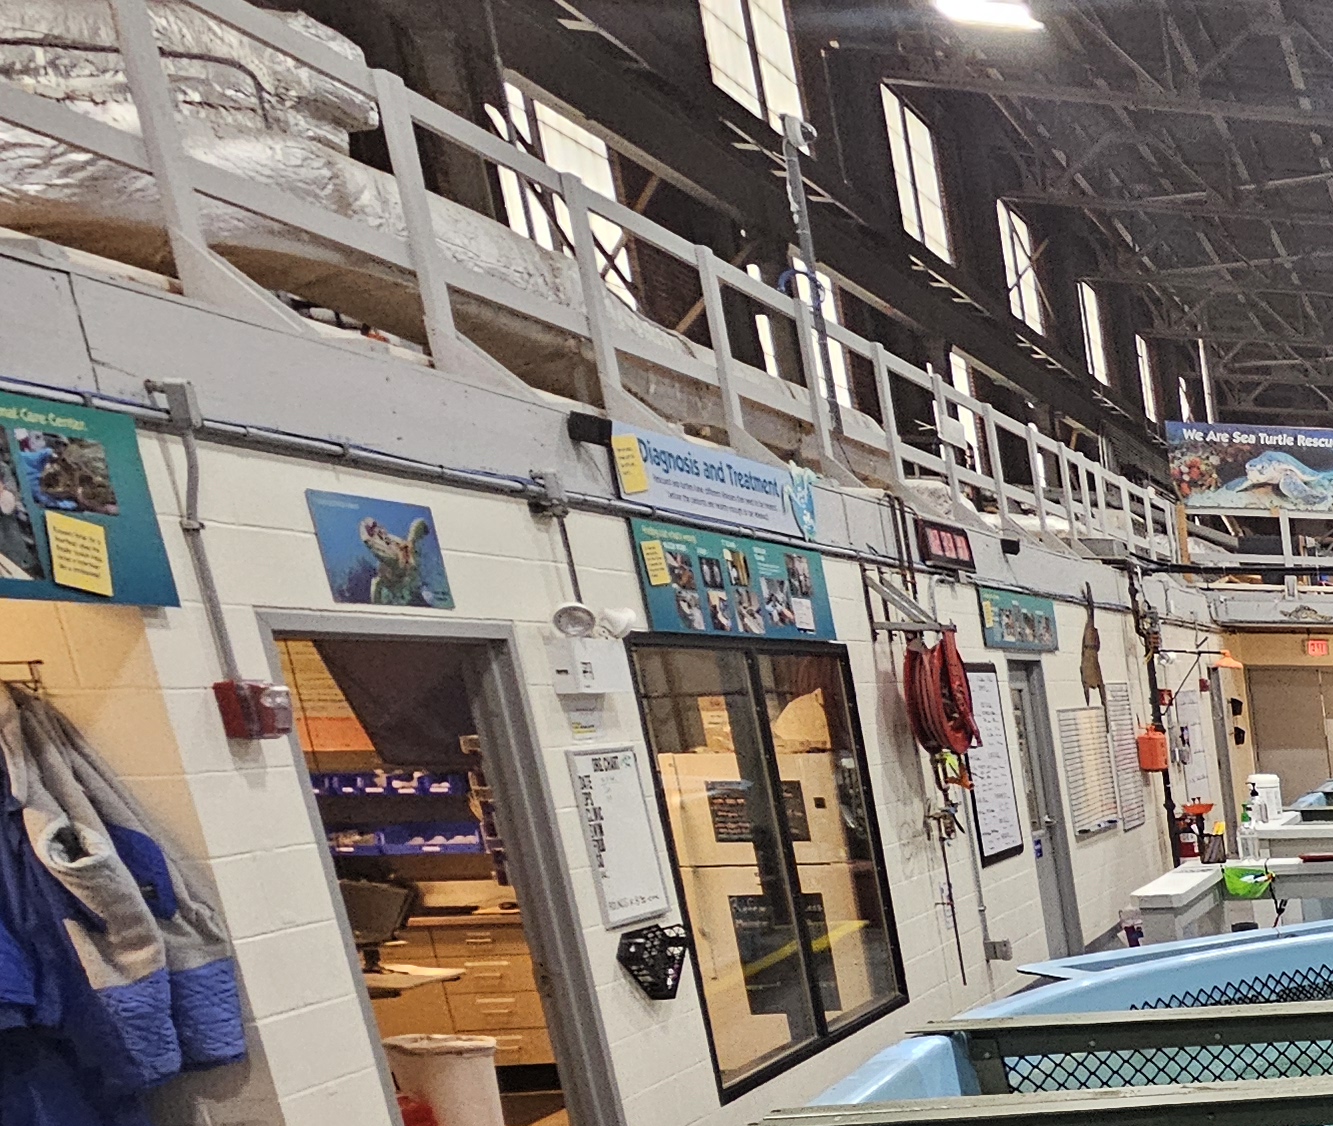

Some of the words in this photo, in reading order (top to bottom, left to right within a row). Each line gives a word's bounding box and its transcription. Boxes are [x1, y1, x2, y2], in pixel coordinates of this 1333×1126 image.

[1182, 428, 1204, 441] We
[1206, 429, 1230, 442] Are
[1232, 431, 1256, 444] Sea
[1258, 432, 1294, 447] Turtle
[637, 437, 700, 474] Diagnosis
[703, 460, 725, 484] and
[726, 464, 780, 498] Treatment
